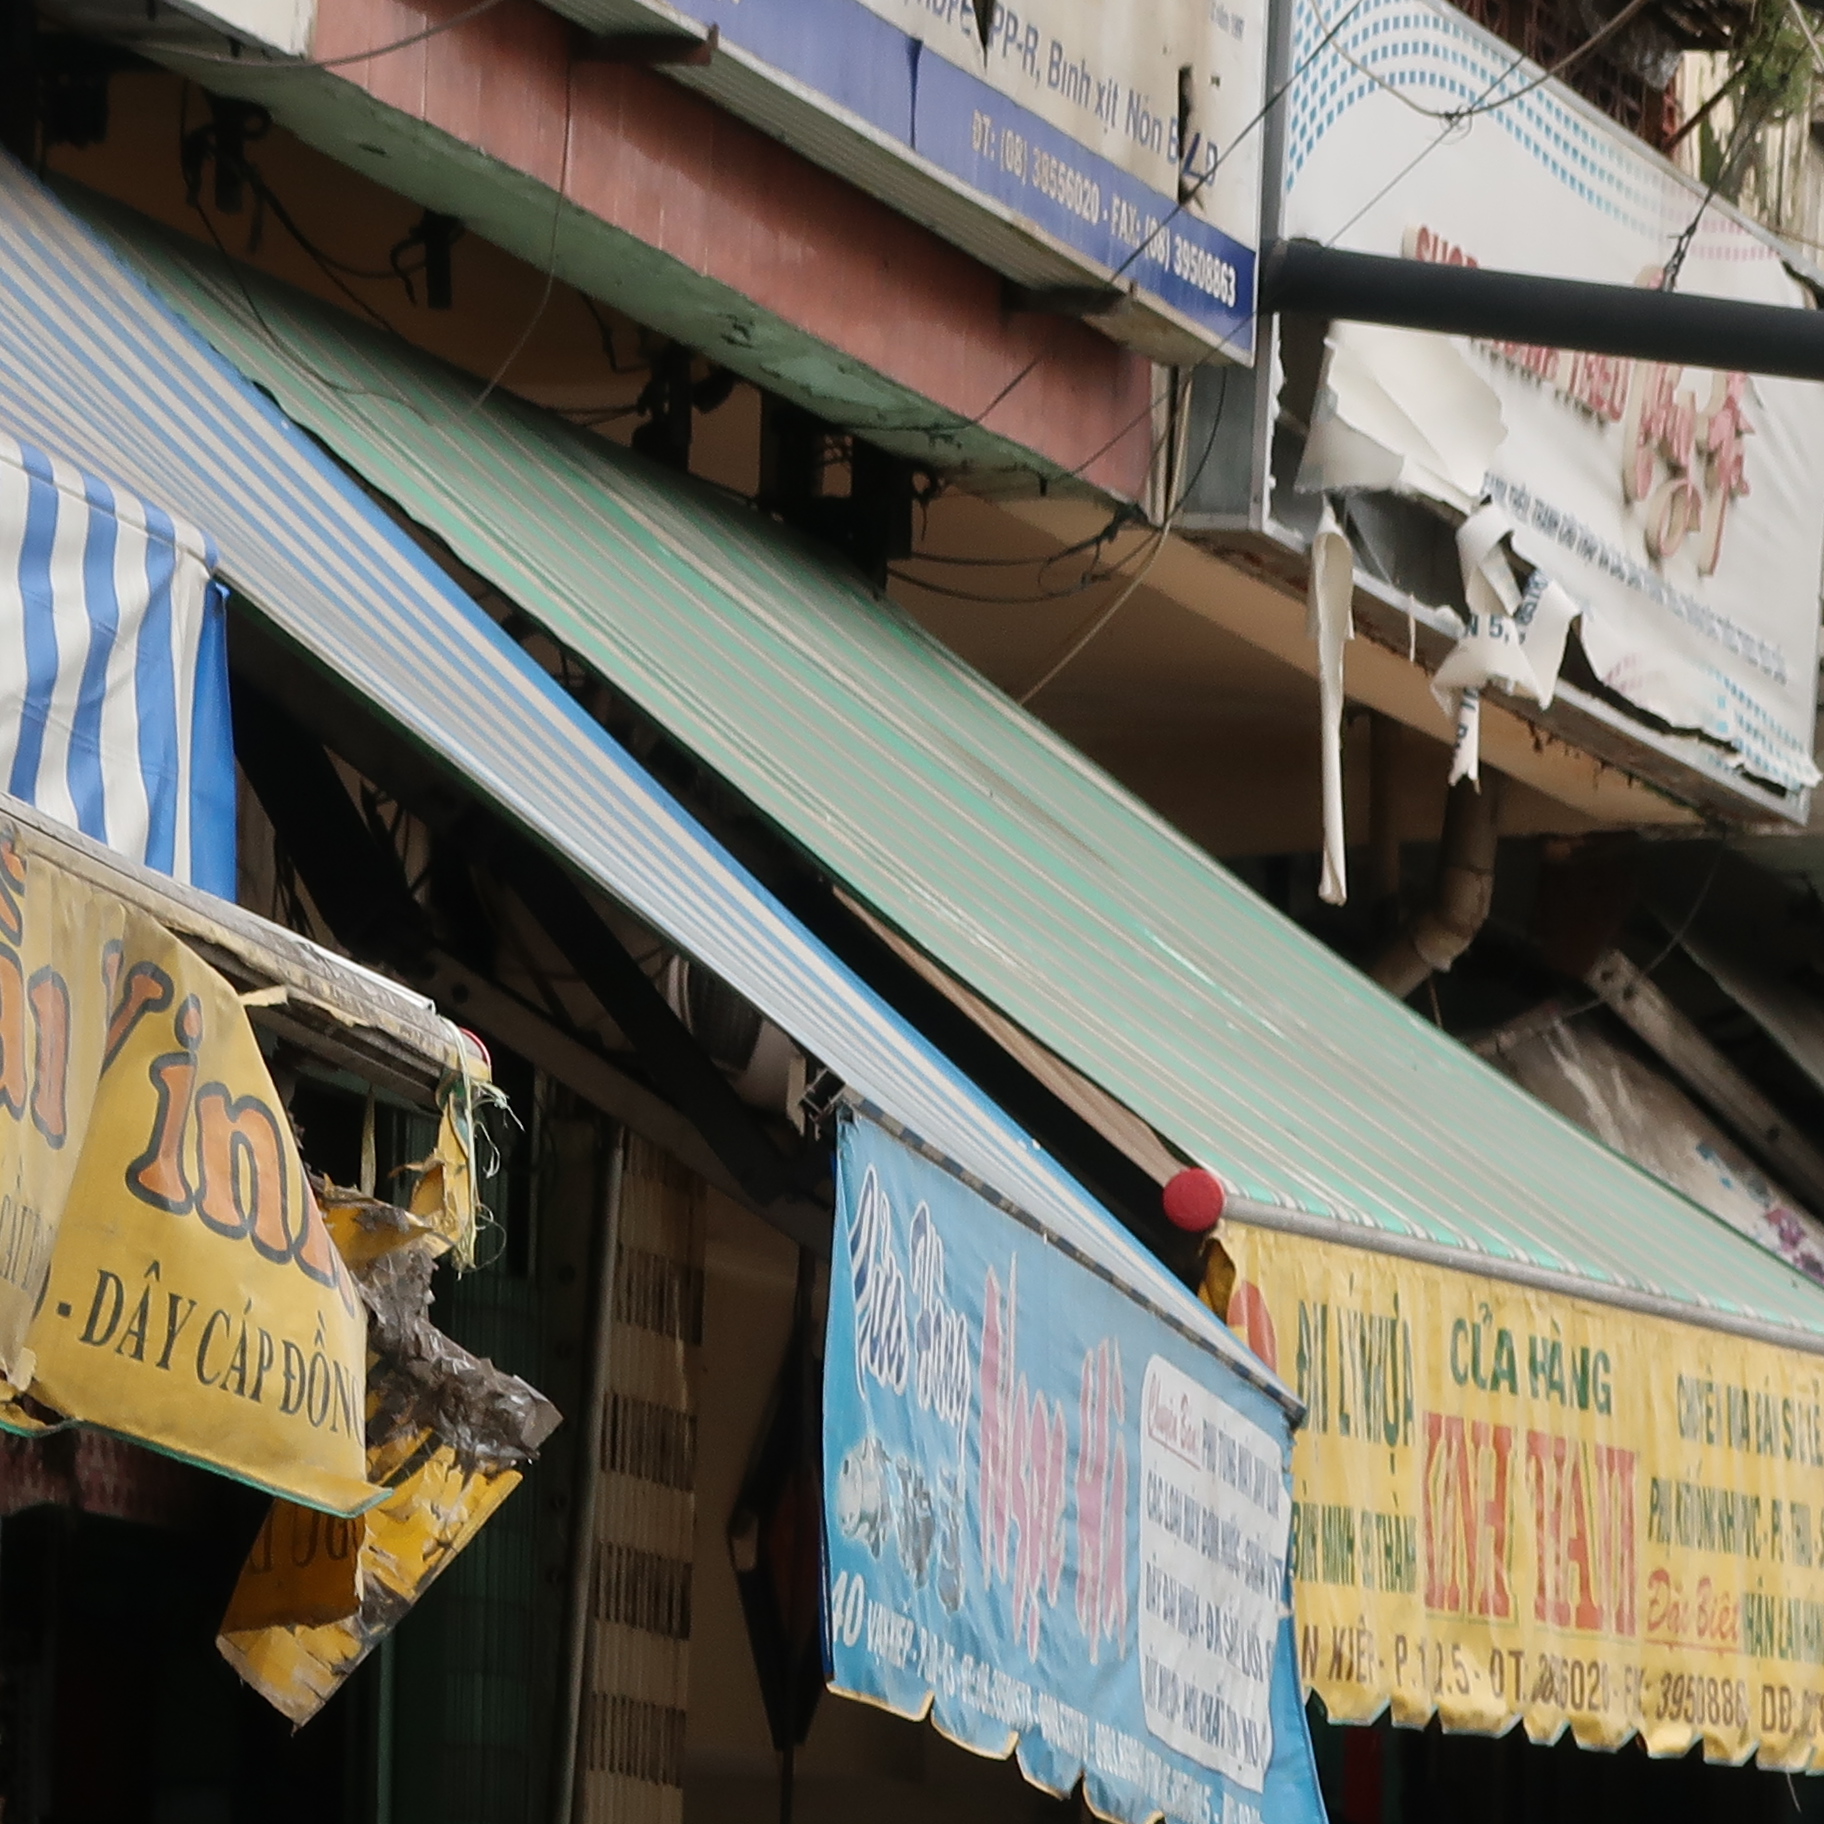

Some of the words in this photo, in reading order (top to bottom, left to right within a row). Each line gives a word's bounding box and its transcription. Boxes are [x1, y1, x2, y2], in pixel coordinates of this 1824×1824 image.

[1172, 233, 1236, 308] 39508863
[79, 1260, 196, 1371] DÂY
[197, 1296, 274, 1404] CÁP
[1450, 1302, 1519, 1396] CỬA
[1528, 1315, 1612, 1416] HÀNG
